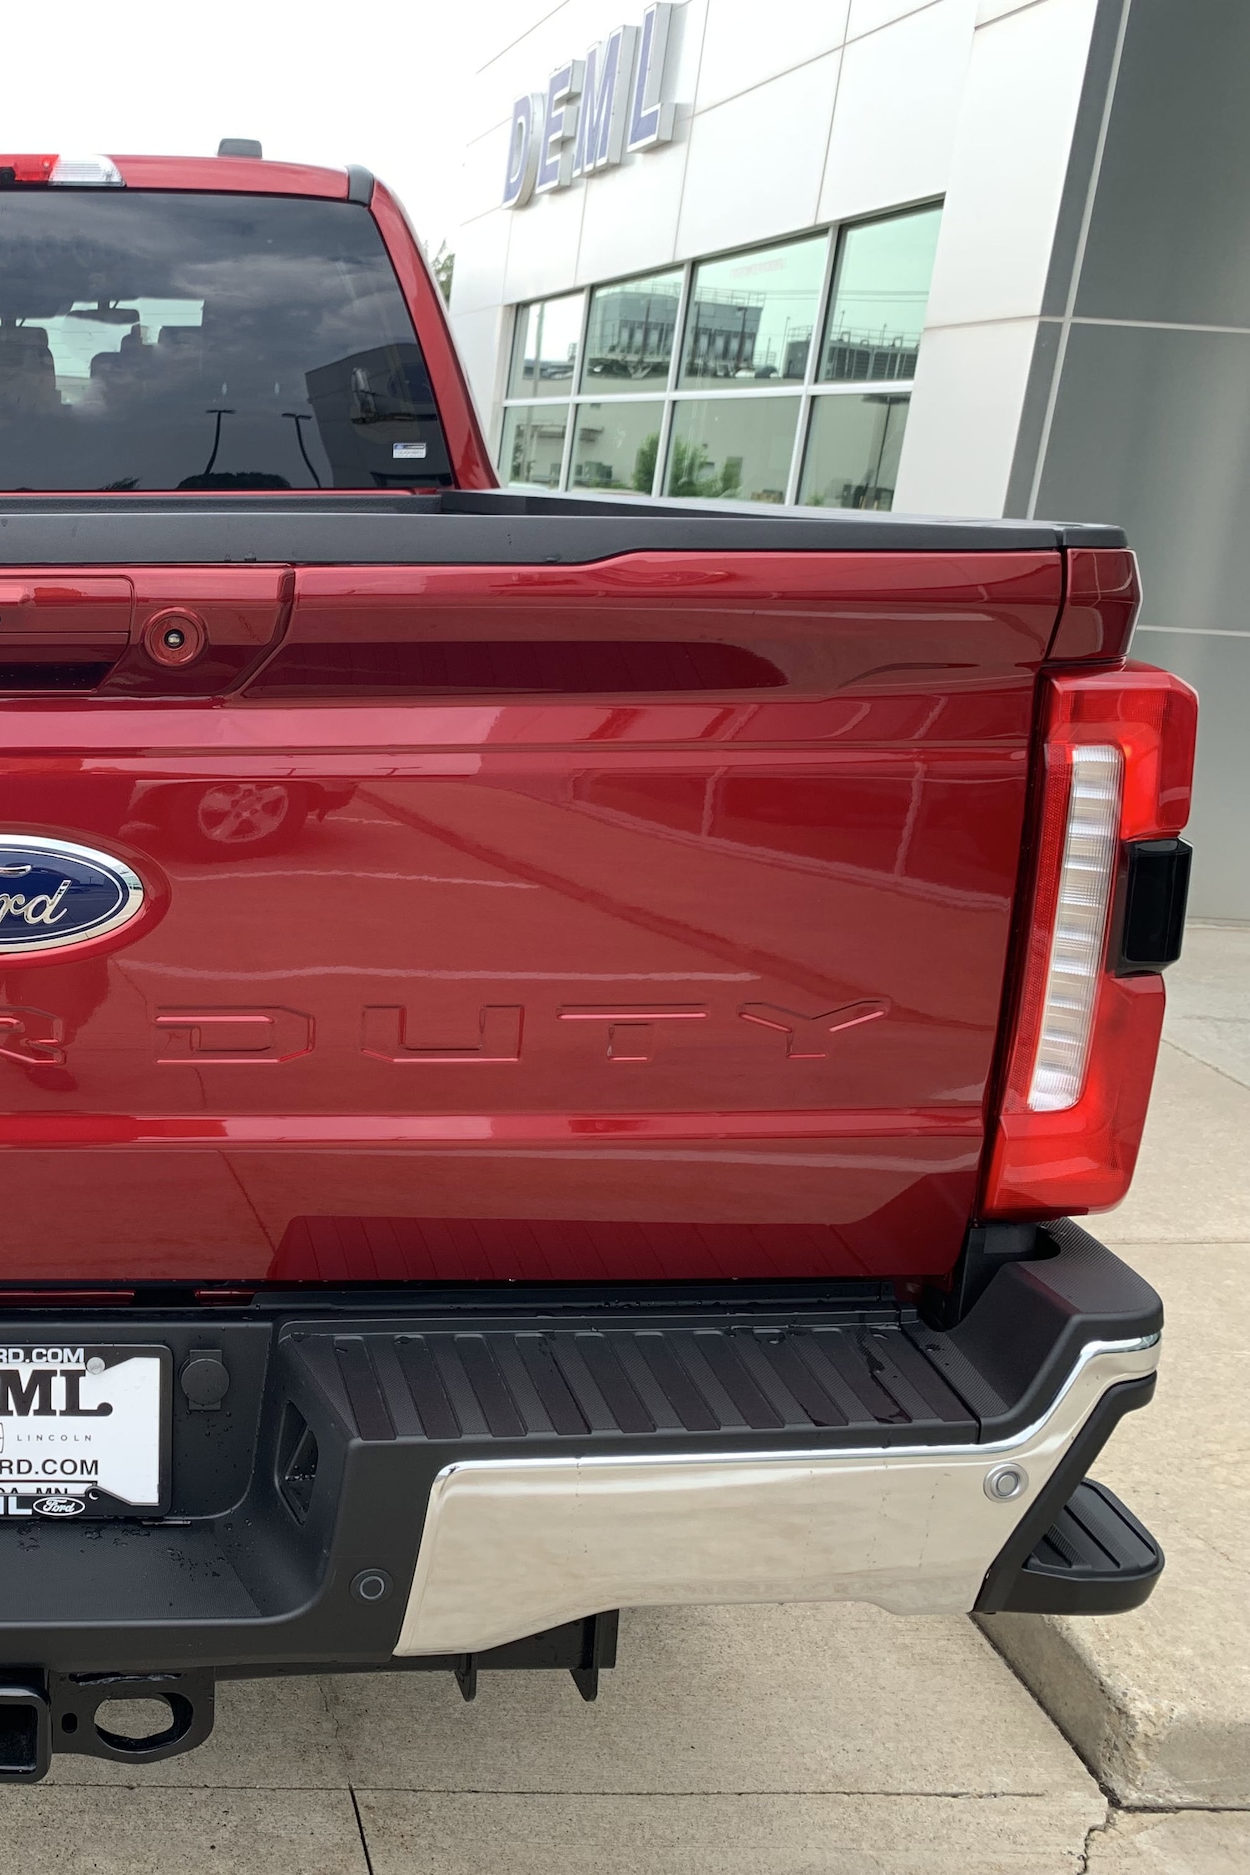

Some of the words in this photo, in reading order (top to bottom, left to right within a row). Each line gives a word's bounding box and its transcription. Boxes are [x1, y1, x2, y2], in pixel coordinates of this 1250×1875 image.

[501, 2, 672, 210] DEML
[152, 1000, 890, 1064] DUTY
[16, 1433, 93, 1442] LINCOLN
[42, 1499, 76, 1513] Ford
